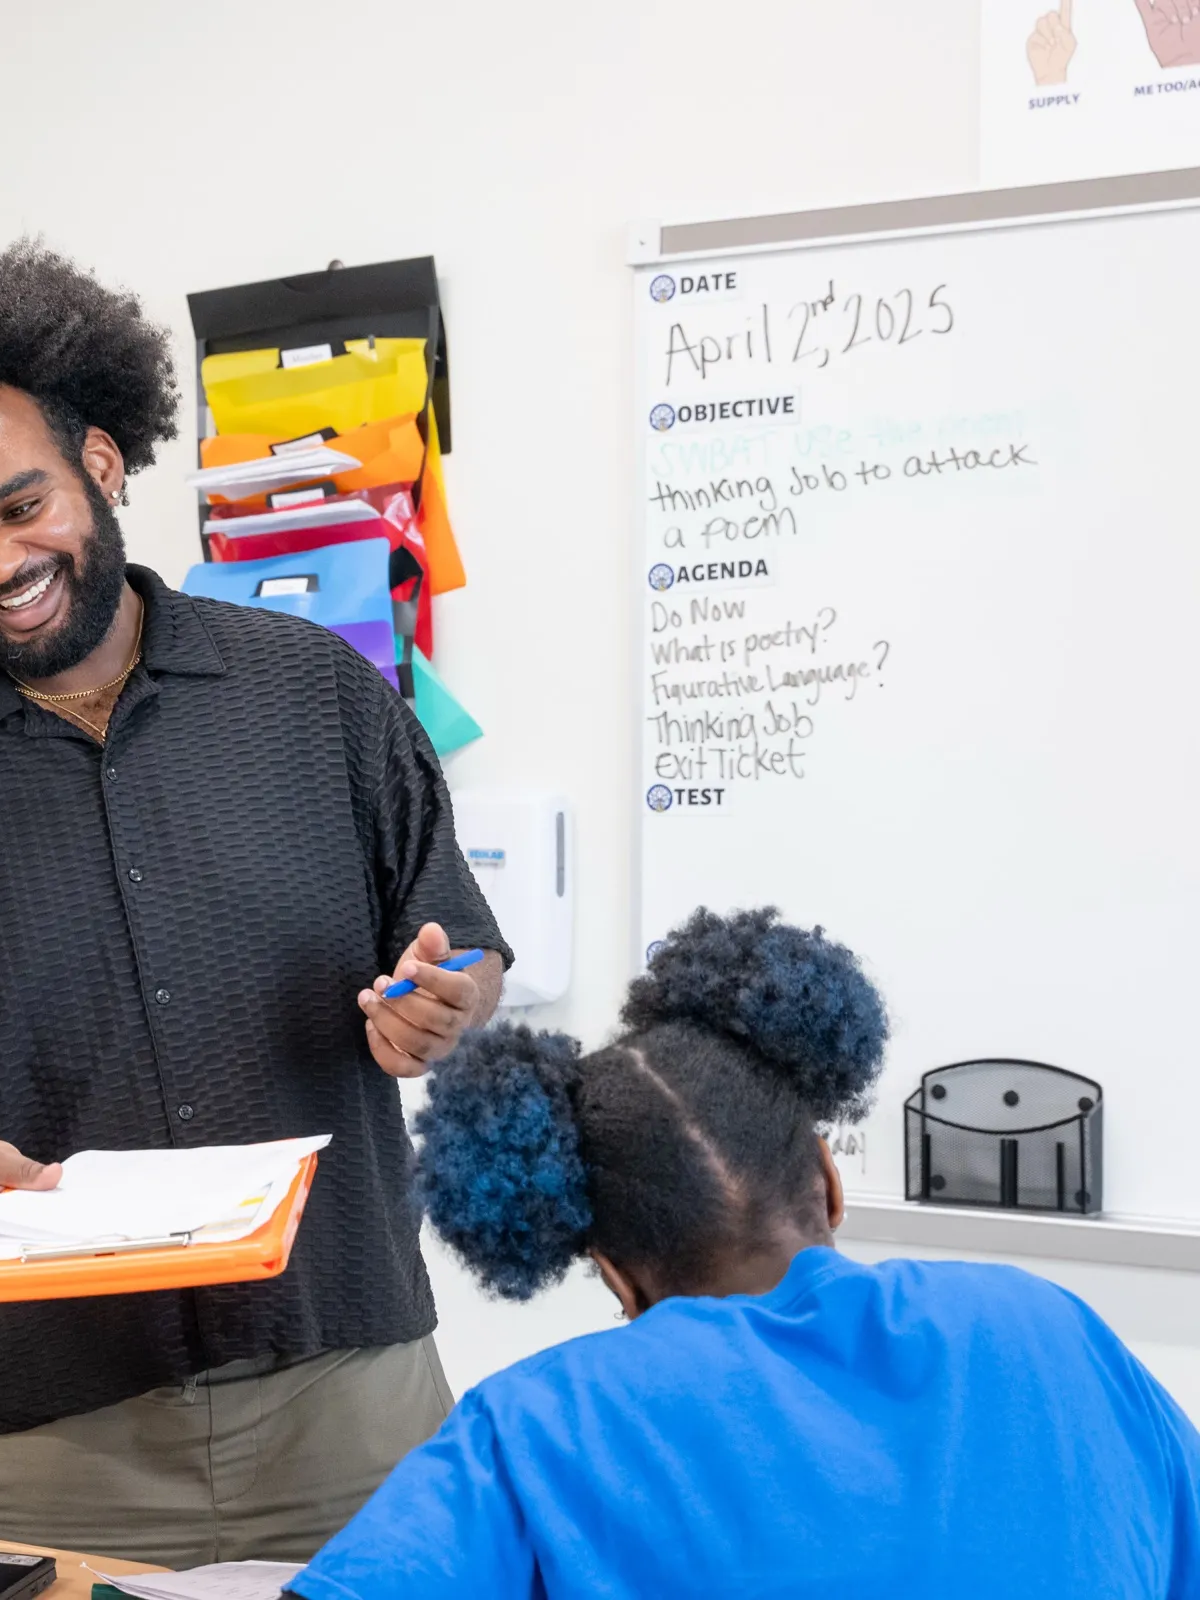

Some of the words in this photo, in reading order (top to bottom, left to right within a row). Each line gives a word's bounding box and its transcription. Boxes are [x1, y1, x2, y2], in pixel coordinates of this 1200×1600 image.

[1028, 93, 1080, 110] SUPPLY
[1134, 85, 1154, 97] ME
[1157, 79, 1200, 93] TOO/A
[680, 272, 737, 294] DATE
[665, 303, 771, 386] April
[842, 283, 954, 354] 2025
[677, 395, 795, 423] OBJECTIVE
[649, 475, 777, 512] thinking
[855, 460, 891, 485] to
[903, 443, 1038, 477] attack
[663, 526, 686, 549] a
[700, 507, 797, 549] poem
[676, 559, 769, 583] AGENDA
[651, 601, 682, 632] Do
[690, 597, 746, 625] Now
[650, 634, 715, 666] What
[744, 606, 836, 668] poetry?
[652, 670, 765, 706] Figurative
[646, 707, 758, 746] Thinking
[763, 699, 814, 738] Job
[708, 737, 805, 780] Ticket
[674, 788, 725, 806] TEST
